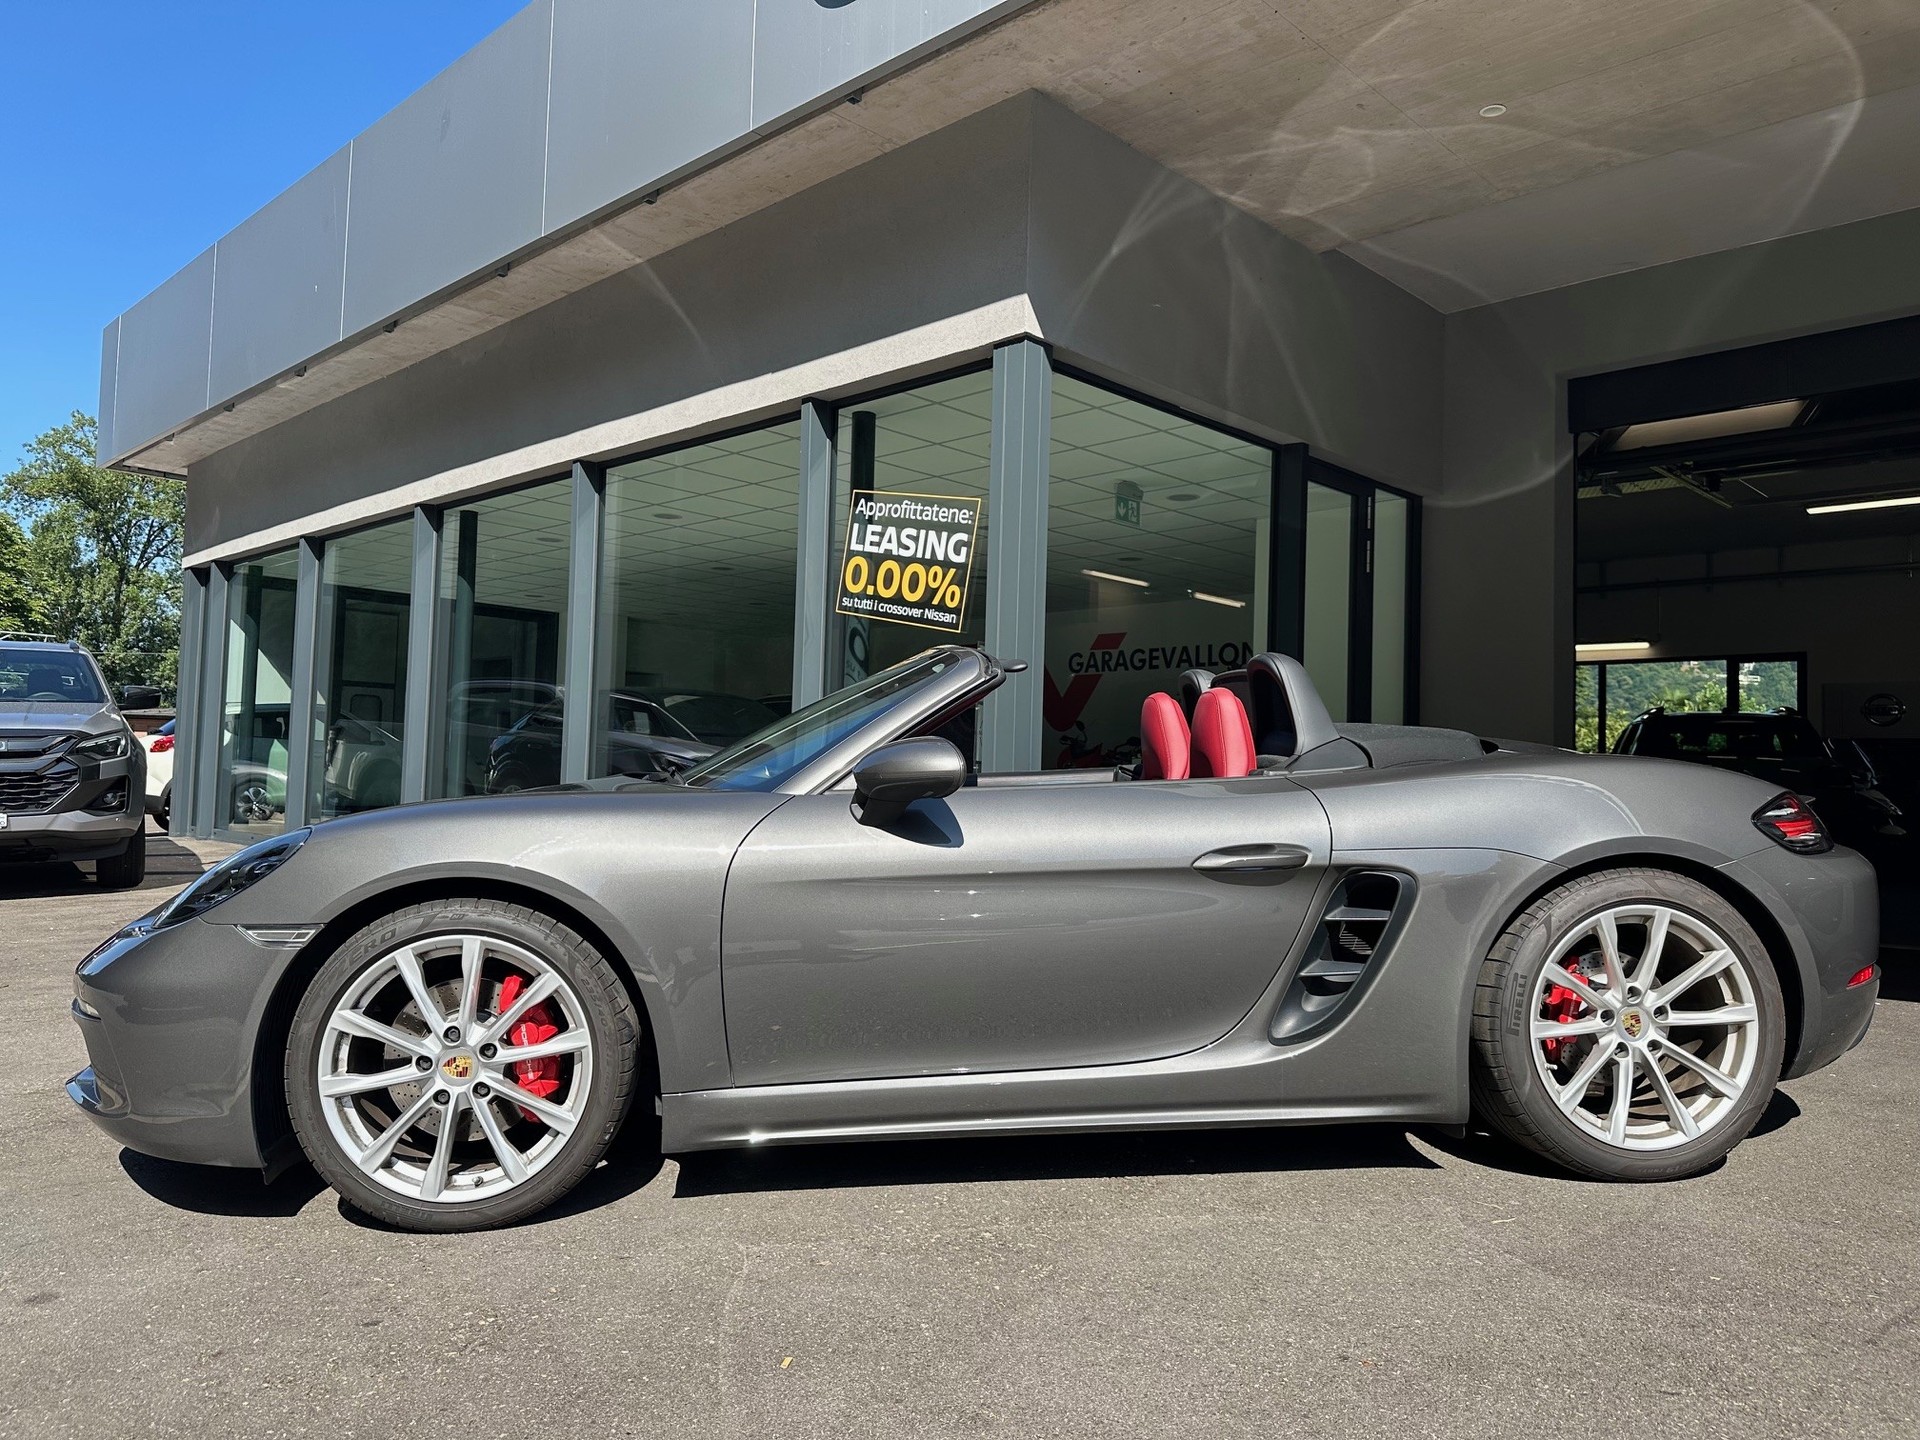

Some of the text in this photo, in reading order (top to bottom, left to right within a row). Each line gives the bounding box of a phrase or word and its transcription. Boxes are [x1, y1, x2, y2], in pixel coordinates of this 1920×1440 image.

[855, 498, 973, 524] Approfittatene:
[850, 523, 968, 563] LEASING
[845, 556, 961, 608] 0.00%
[842, 597, 854, 607] su
[854, 599, 873, 611] tutti
[878, 603, 923, 618] crossover
[924, 608, 957, 624] Nissan
[1505, 972, 1528, 1037] PIRELLI
